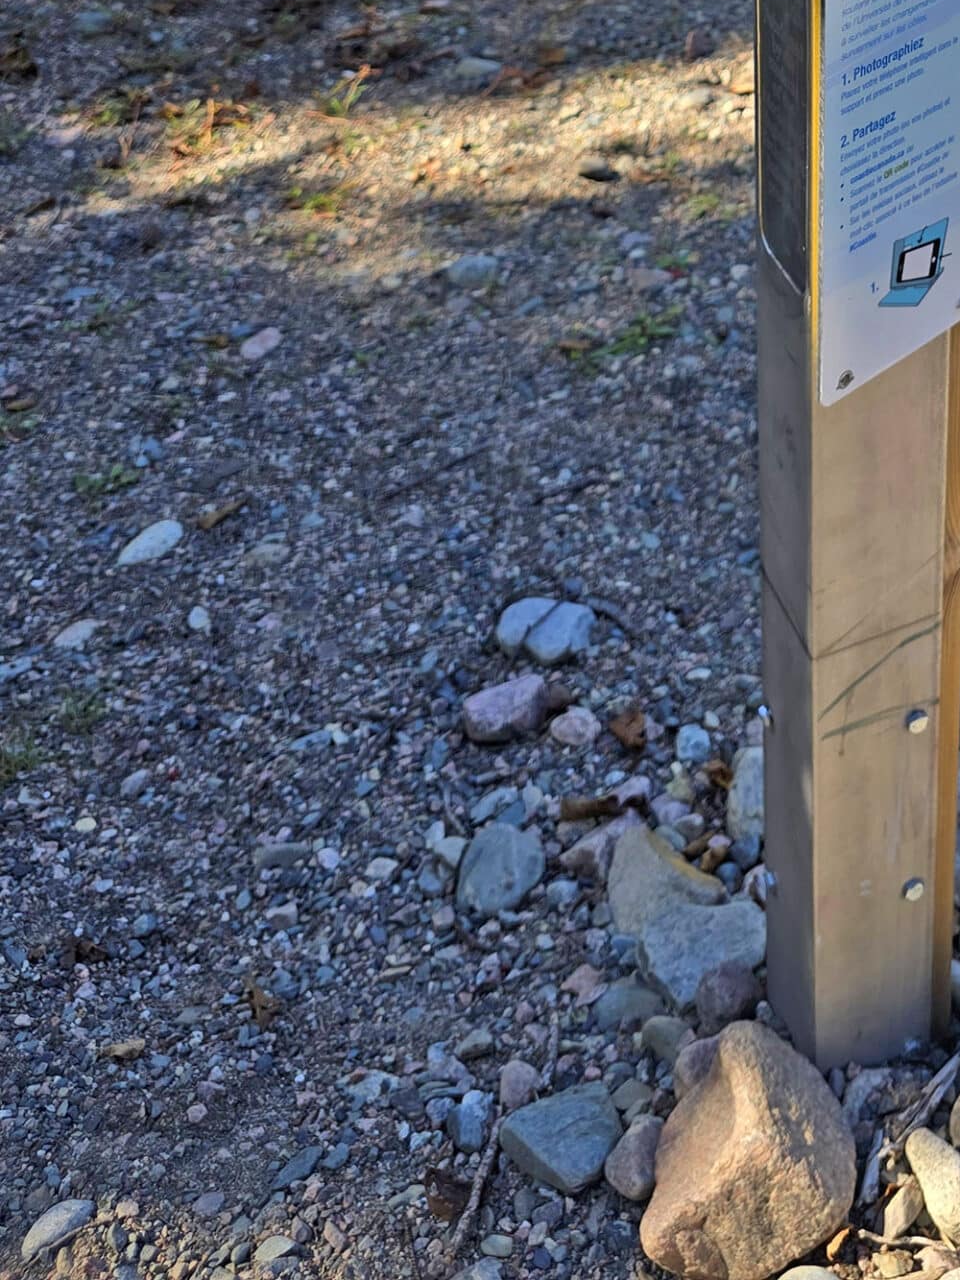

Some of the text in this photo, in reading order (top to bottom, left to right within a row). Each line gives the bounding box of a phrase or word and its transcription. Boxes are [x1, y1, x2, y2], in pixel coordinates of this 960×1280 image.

[842, 37, 924, 86] 1. Photographiez
[840, 135, 850, 149] 2.
[852, 111, 896, 142] Partagez
